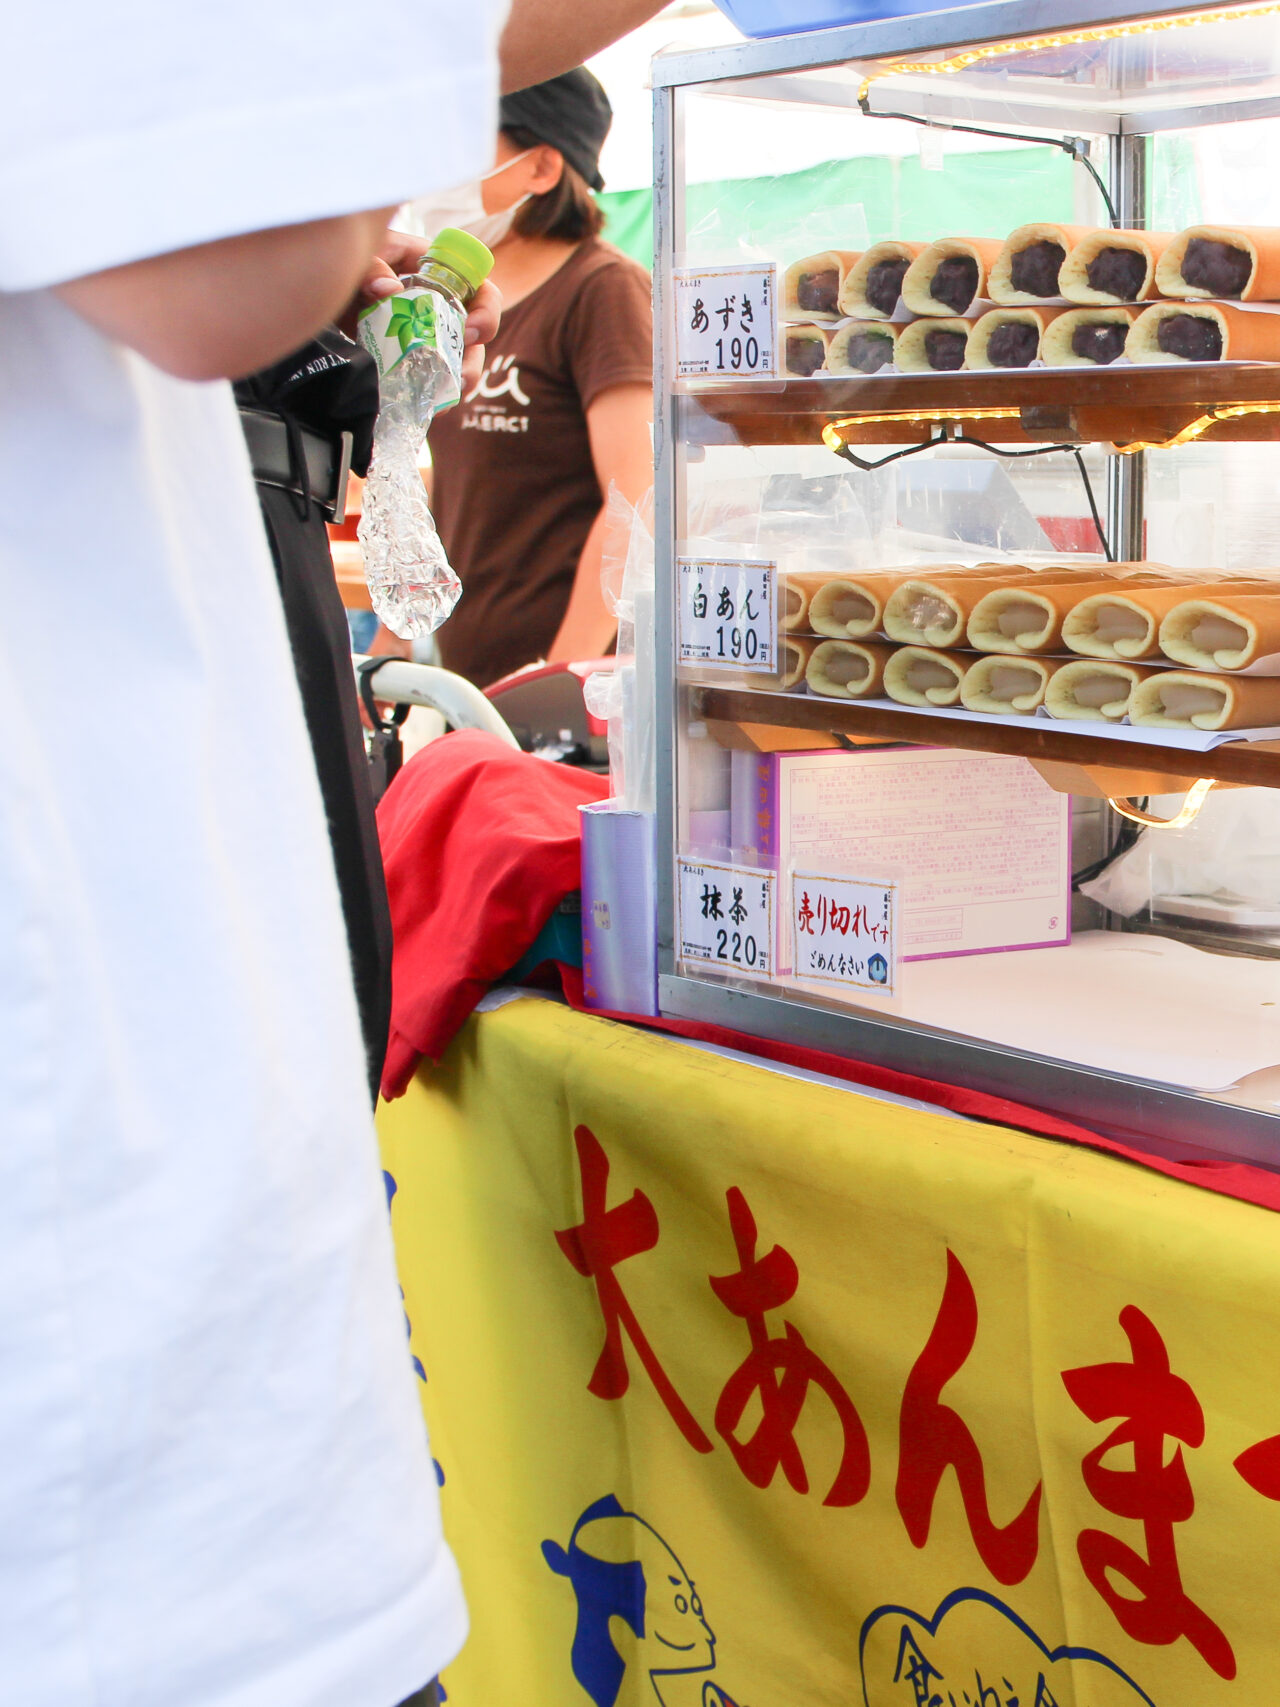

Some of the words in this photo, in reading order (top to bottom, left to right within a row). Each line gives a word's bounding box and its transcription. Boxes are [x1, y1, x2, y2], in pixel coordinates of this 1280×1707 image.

[690, 293, 754, 334] あずき
[305, 356, 330, 375] RUN
[715, 336, 759, 370] 190
[693, 582, 760, 621] 白あん
[716, 626, 758, 660] 190
[700, 883, 749, 927] 抹茶
[798, 890, 890, 945] 売り切れです
[716, 928, 757, 967] 220
[810, 950, 865, 976] ごめんなさい
